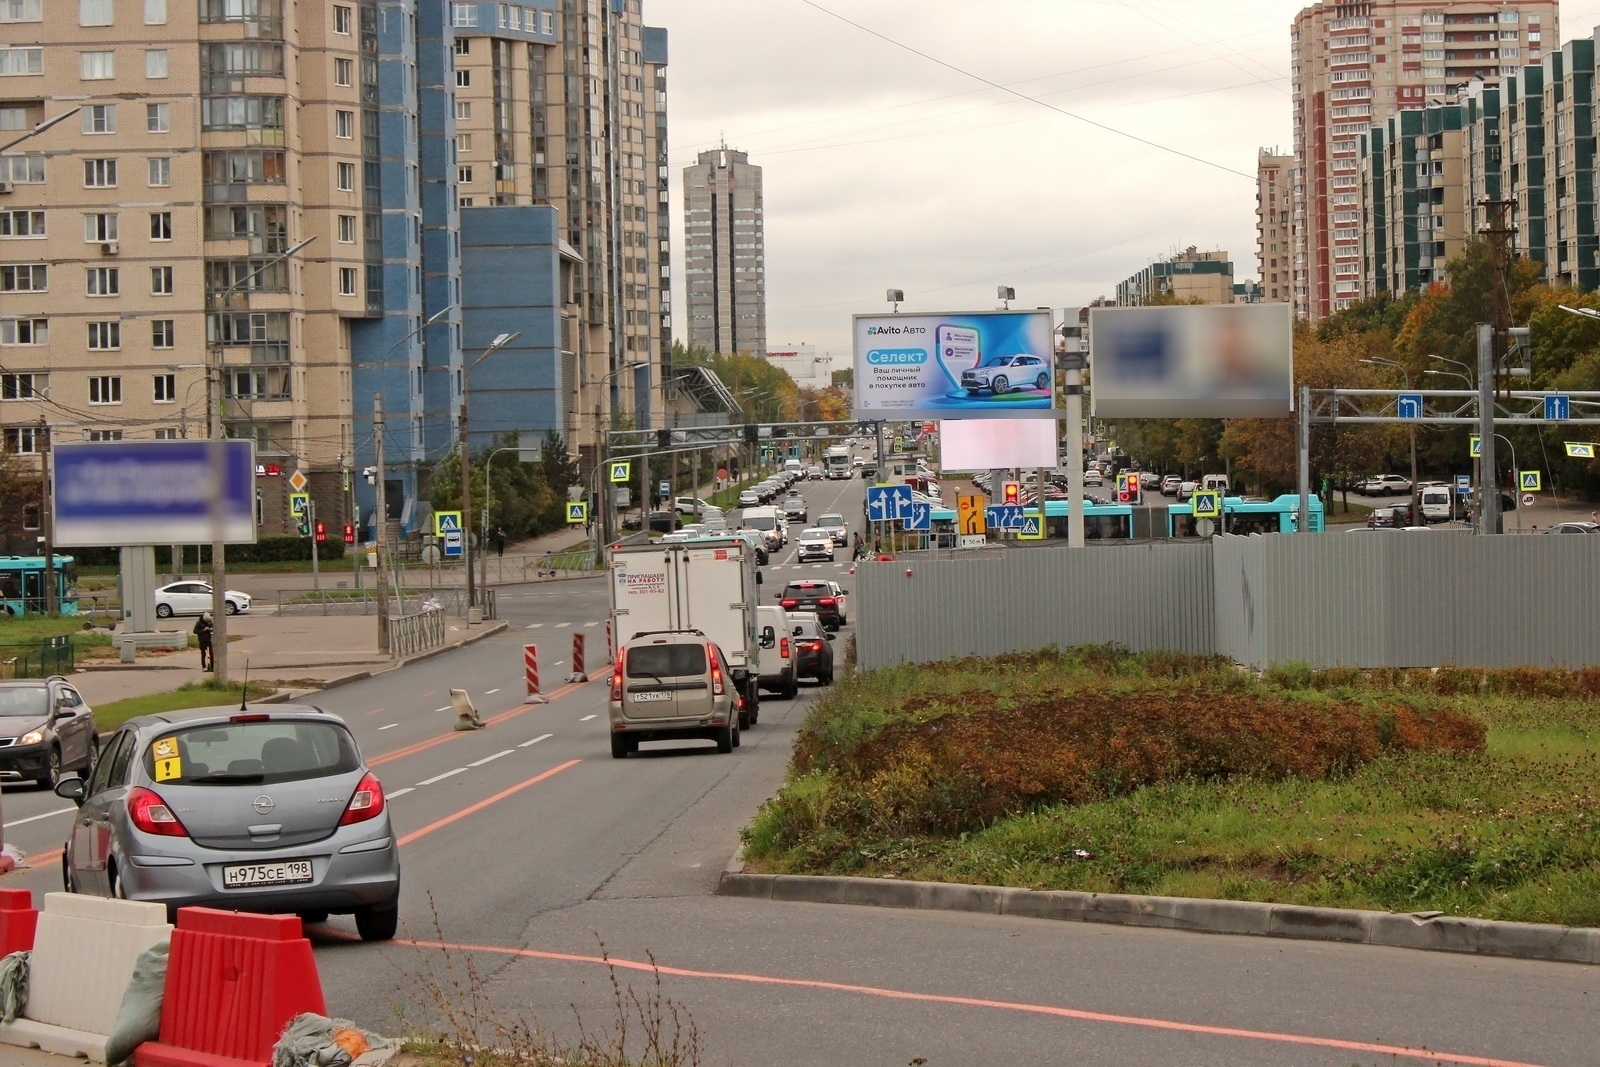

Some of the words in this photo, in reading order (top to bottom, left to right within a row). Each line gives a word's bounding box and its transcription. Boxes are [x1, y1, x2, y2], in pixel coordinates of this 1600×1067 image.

[877, 325, 901, 335] Avito
[902, 325, 926, 334] Авто
[868, 350, 924, 363] Селект
[891, 366, 921, 374] личный
[876, 374, 918, 382] помощник
[164, 761, 171, 777] !
[229, 866, 285, 882] Н975СЕ
[287, 862, 308, 874] 198
